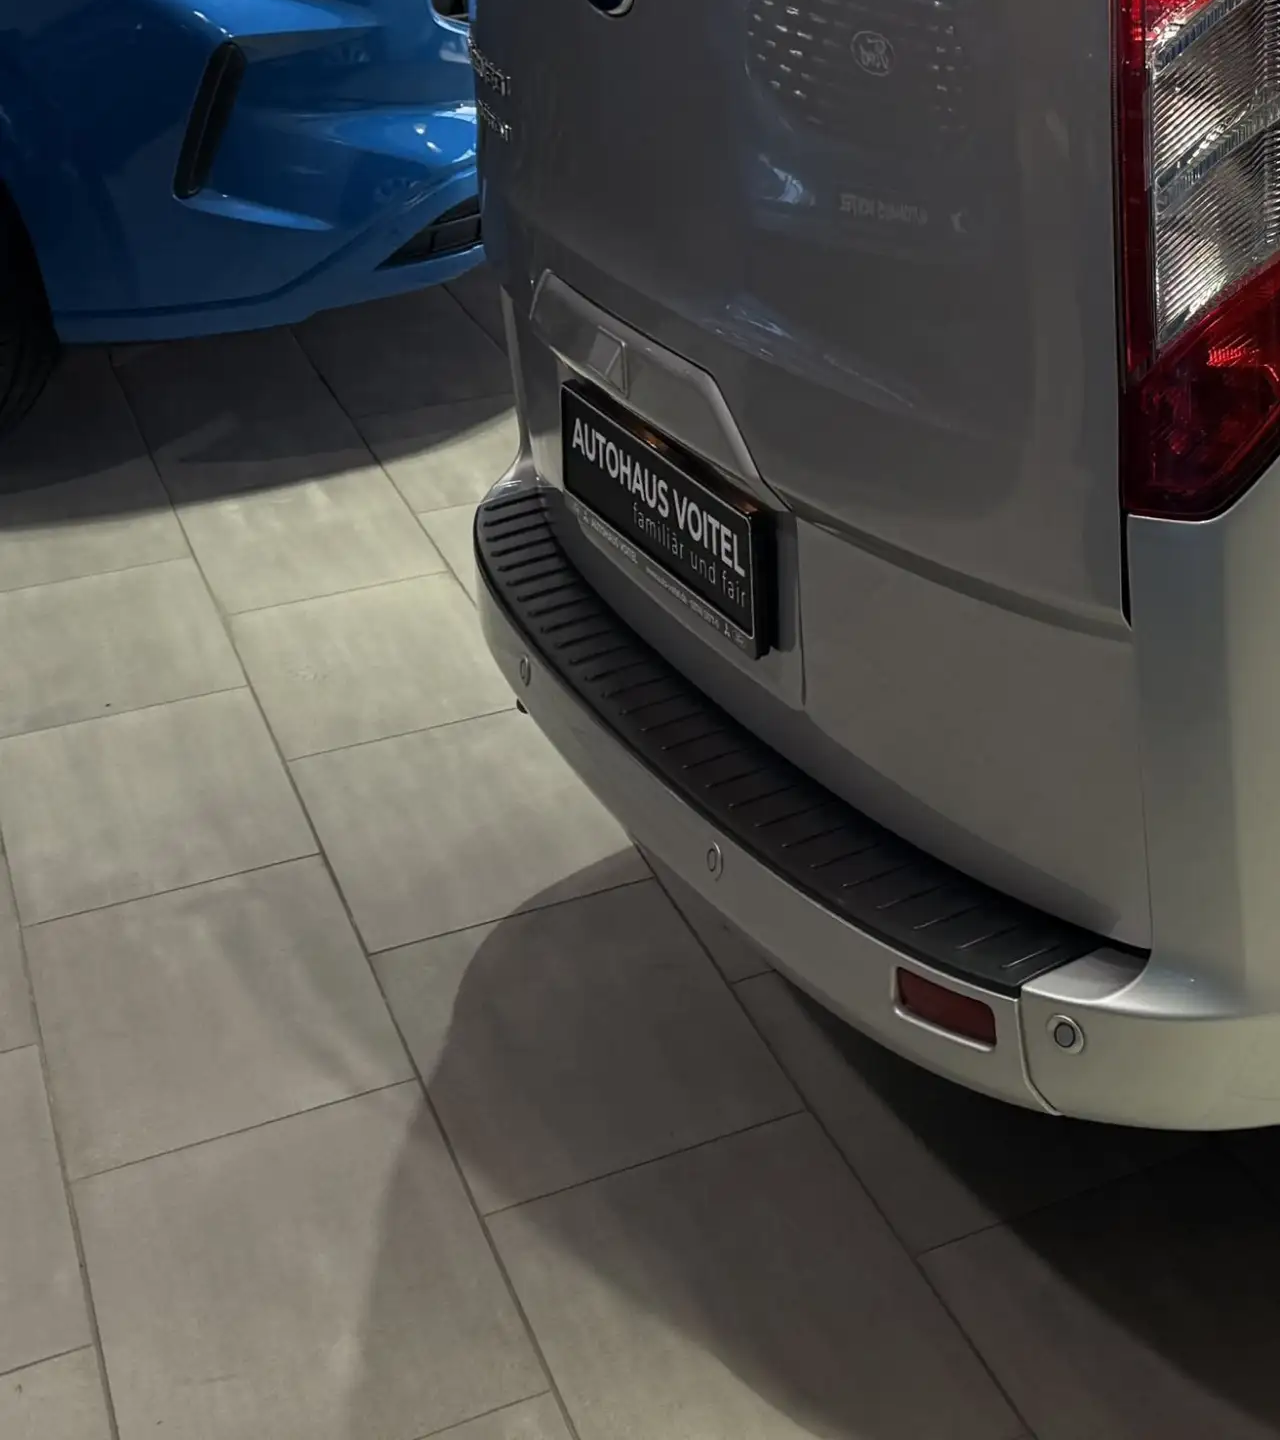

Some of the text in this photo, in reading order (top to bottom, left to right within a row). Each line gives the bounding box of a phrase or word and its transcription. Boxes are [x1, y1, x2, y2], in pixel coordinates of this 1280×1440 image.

[572, 418, 746, 577] AUTOHAUS VOITEL
[633, 502, 685, 561] familiär
[690, 551, 717, 585] und
[722, 570, 747, 608] fair
